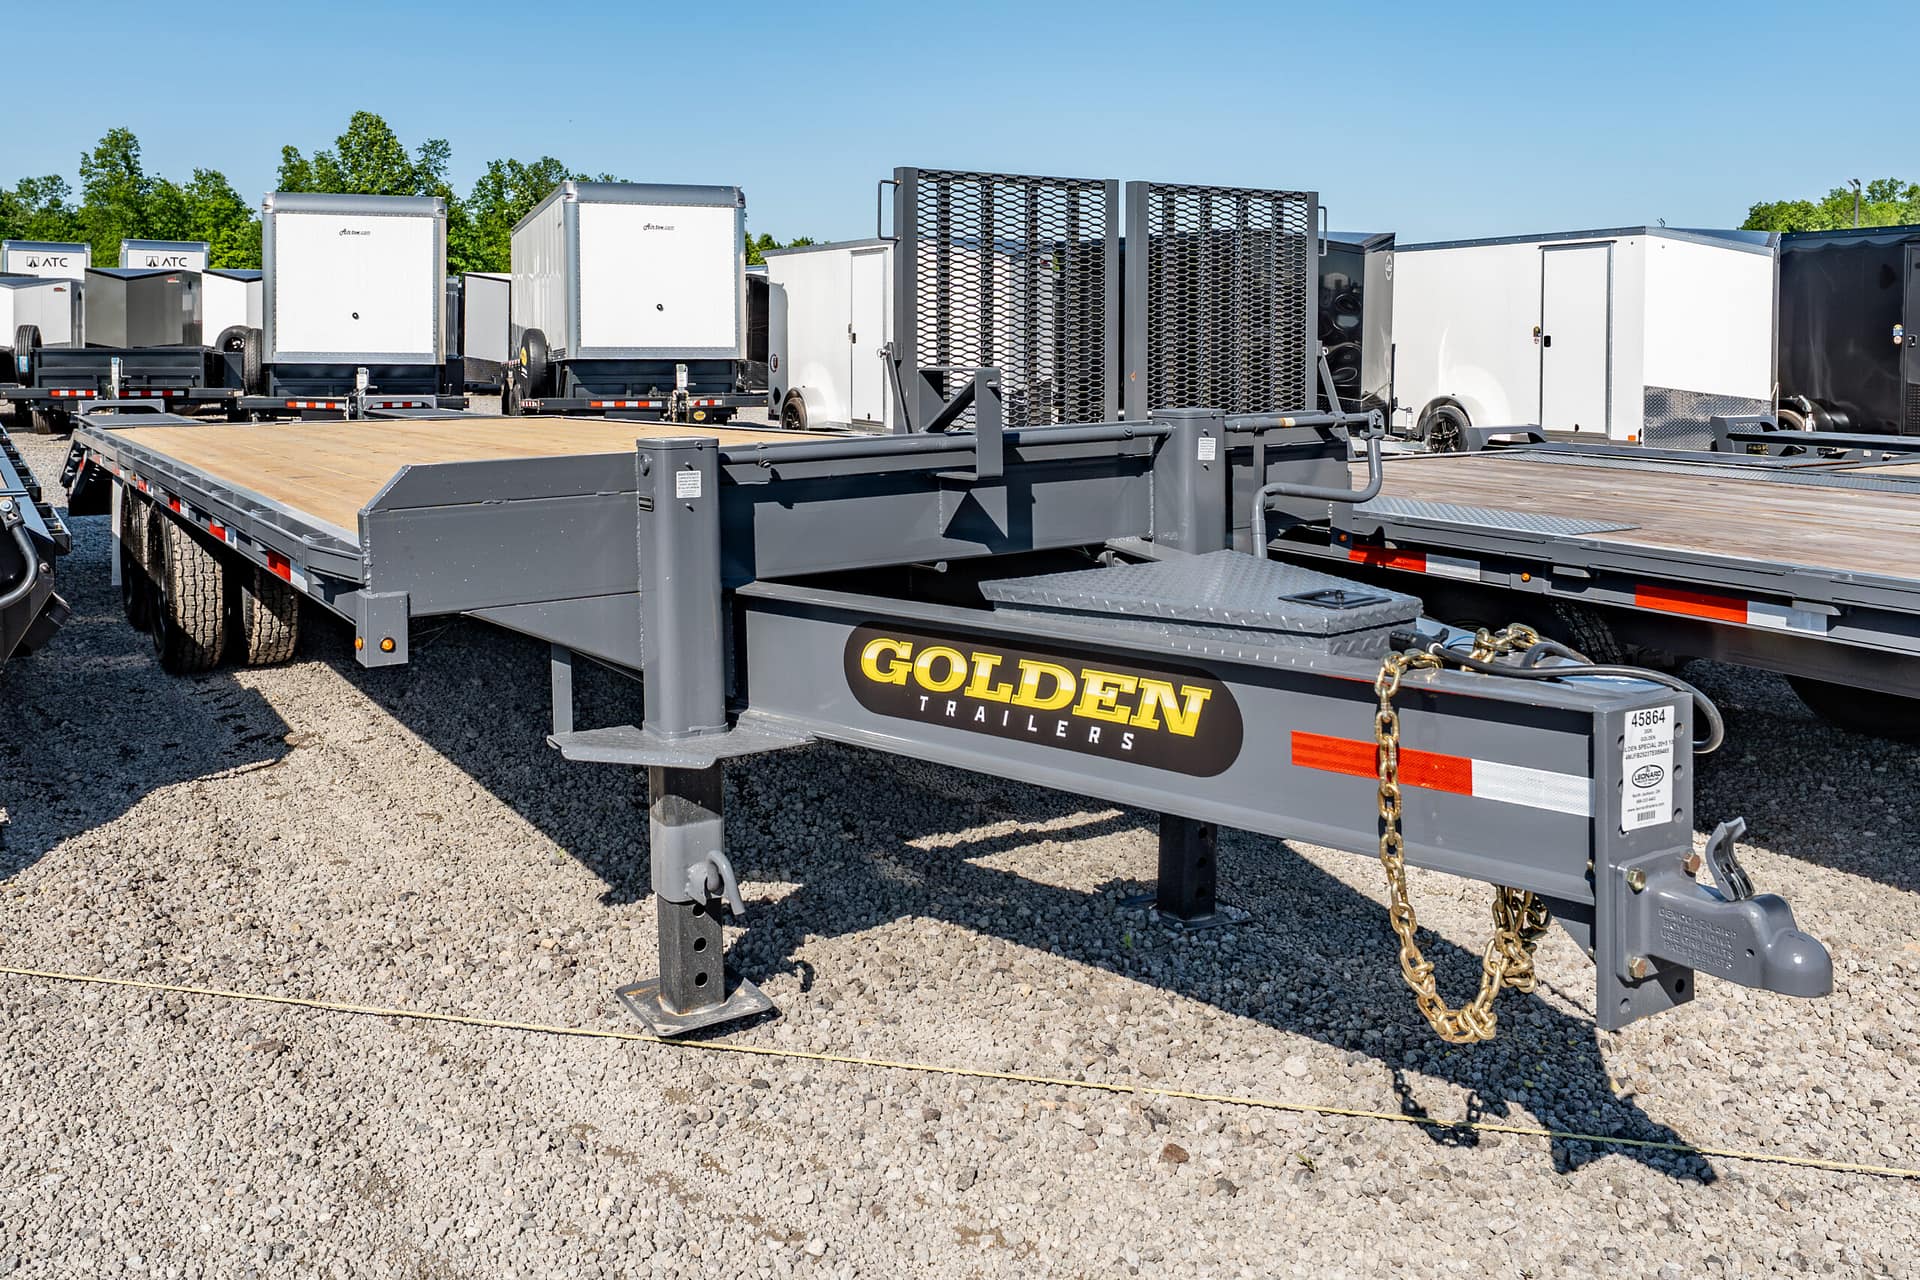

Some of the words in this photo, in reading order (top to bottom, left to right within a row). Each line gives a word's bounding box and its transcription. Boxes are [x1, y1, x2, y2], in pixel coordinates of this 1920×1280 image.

[42, 257, 68, 267] ATC
[161, 257, 188, 267] ATC
[860, 637, 1212, 738] GOLDEN
[918, 695, 1135, 751] TRAILERS
[1631, 709, 1665, 727] 45864
